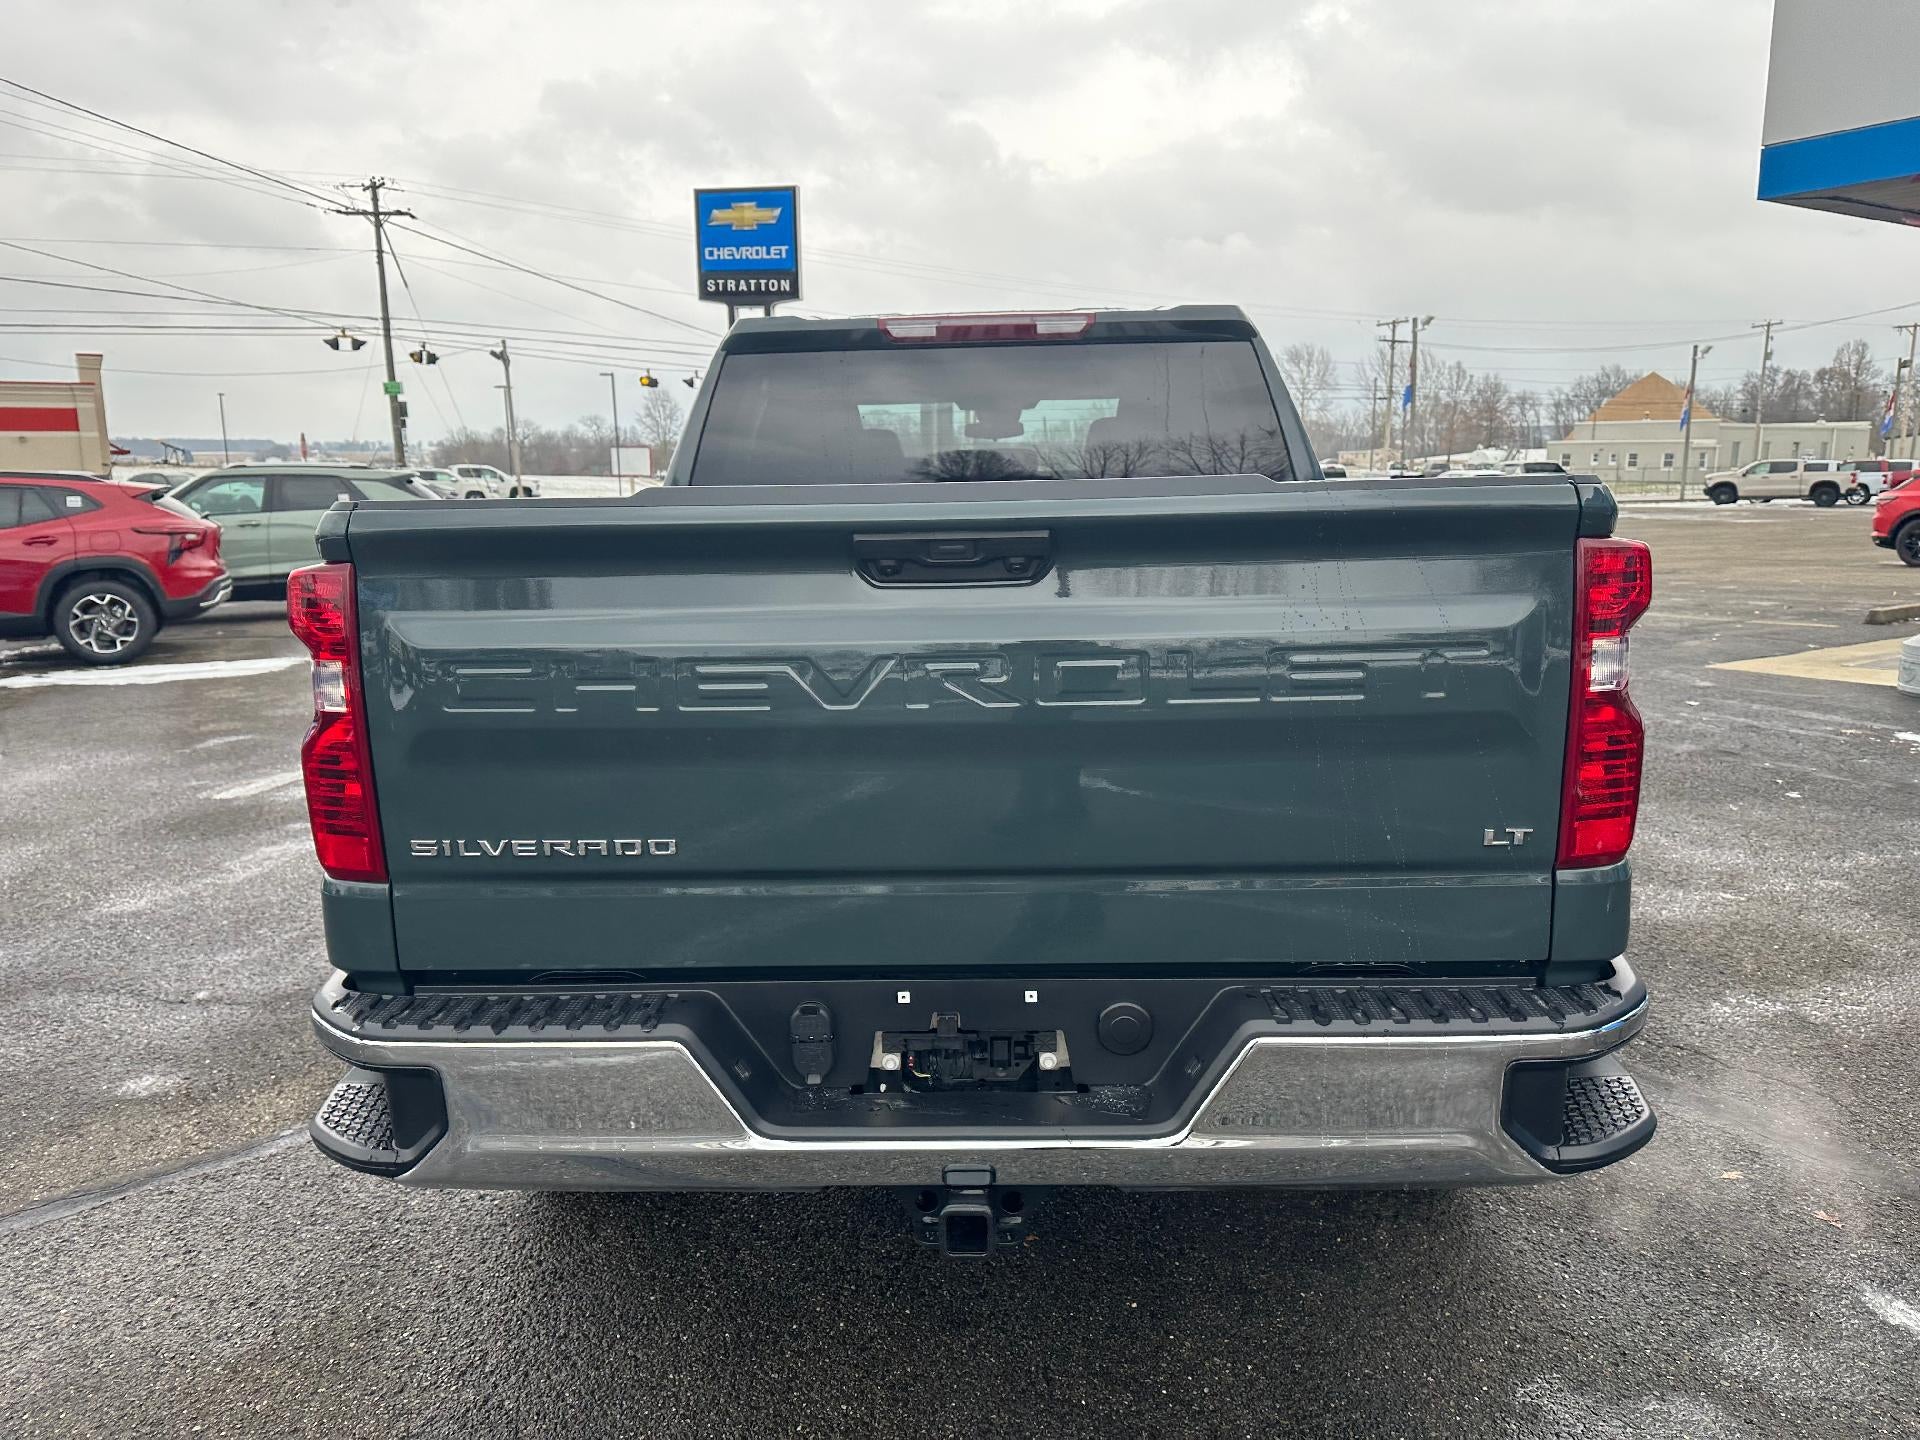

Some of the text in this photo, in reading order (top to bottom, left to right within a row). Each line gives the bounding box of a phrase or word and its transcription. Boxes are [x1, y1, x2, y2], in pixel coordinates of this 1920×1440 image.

[705, 246, 789, 260] CHEVROLET
[707, 280, 791, 292] STRATTON
[437, 643, 1493, 712] CHEVROLET
[1483, 828, 1534, 846] LT
[410, 838, 677, 856] SILVERADO
